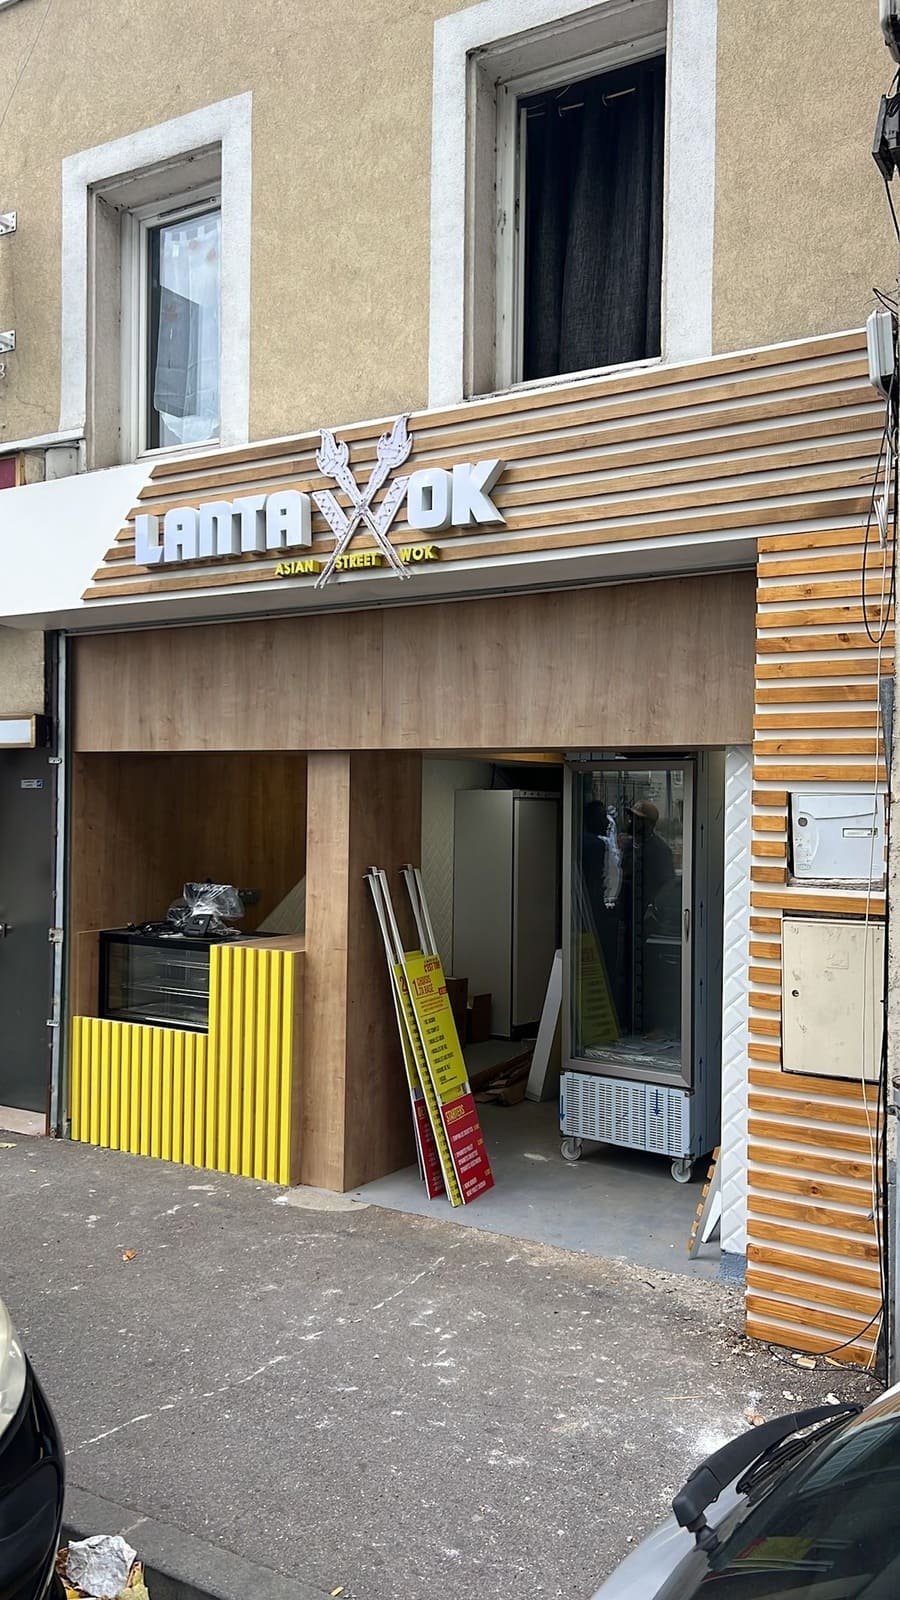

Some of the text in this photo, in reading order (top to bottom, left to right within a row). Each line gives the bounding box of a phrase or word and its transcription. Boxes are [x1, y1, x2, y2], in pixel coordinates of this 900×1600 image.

[135, 490, 312, 567] LANTA
[275, 545, 437, 576] ASIAN STREET WOK
